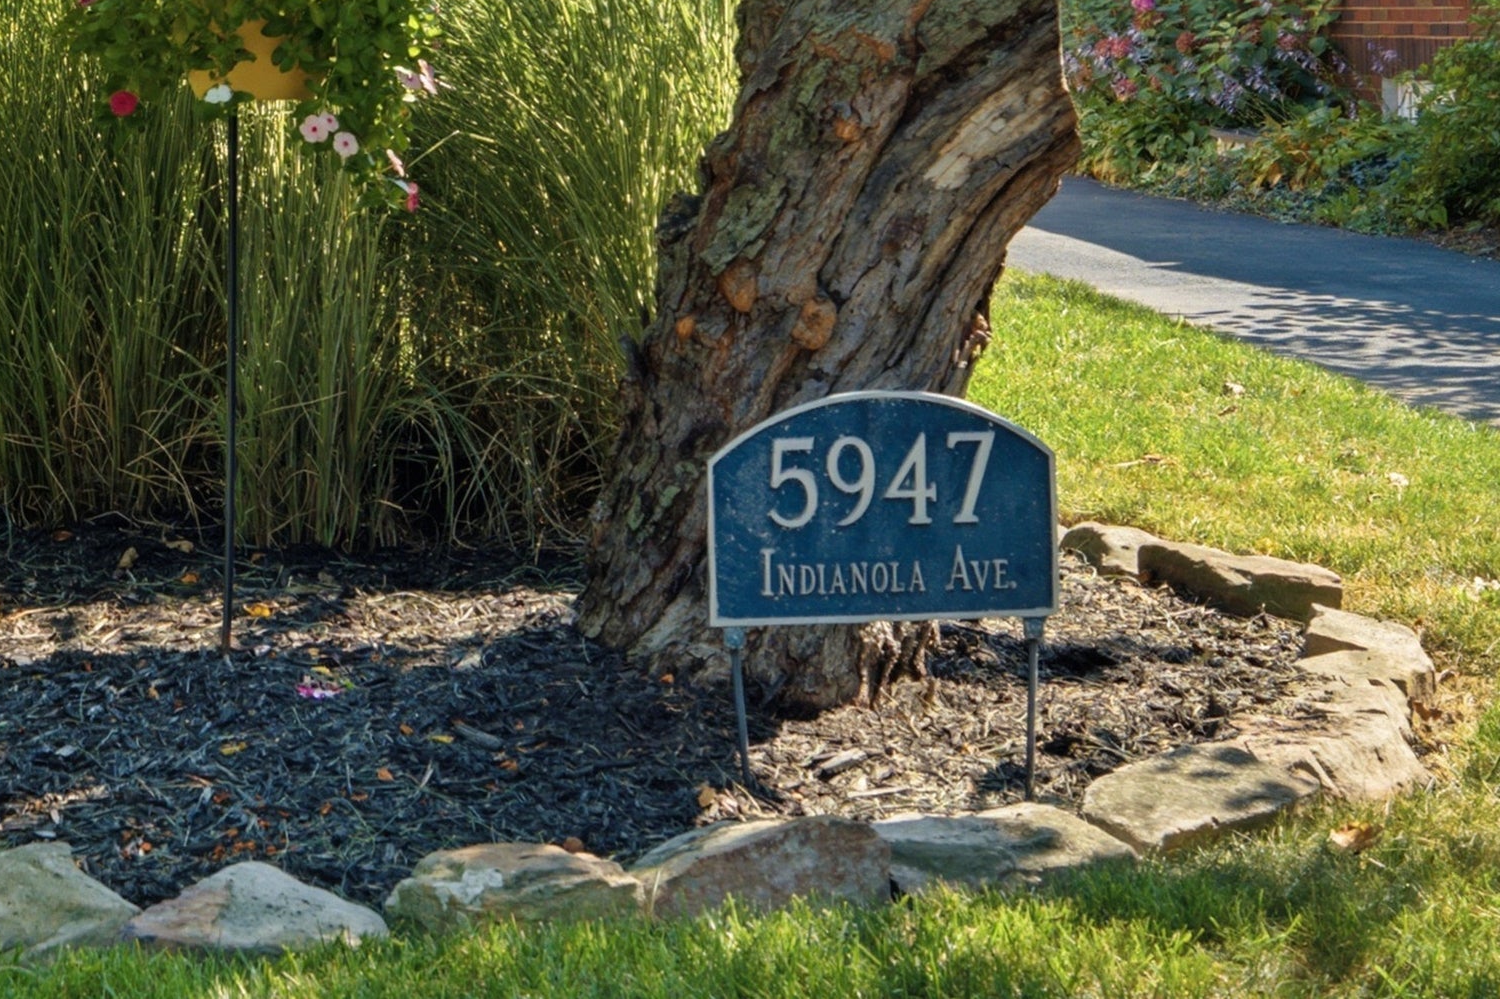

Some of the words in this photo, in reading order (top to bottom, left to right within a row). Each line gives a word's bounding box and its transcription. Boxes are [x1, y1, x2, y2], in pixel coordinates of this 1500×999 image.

[768, 431, 995, 529] 5947
[760, 547, 926, 598] INDIANOLA
[946, 544, 1018, 591] AVE.
